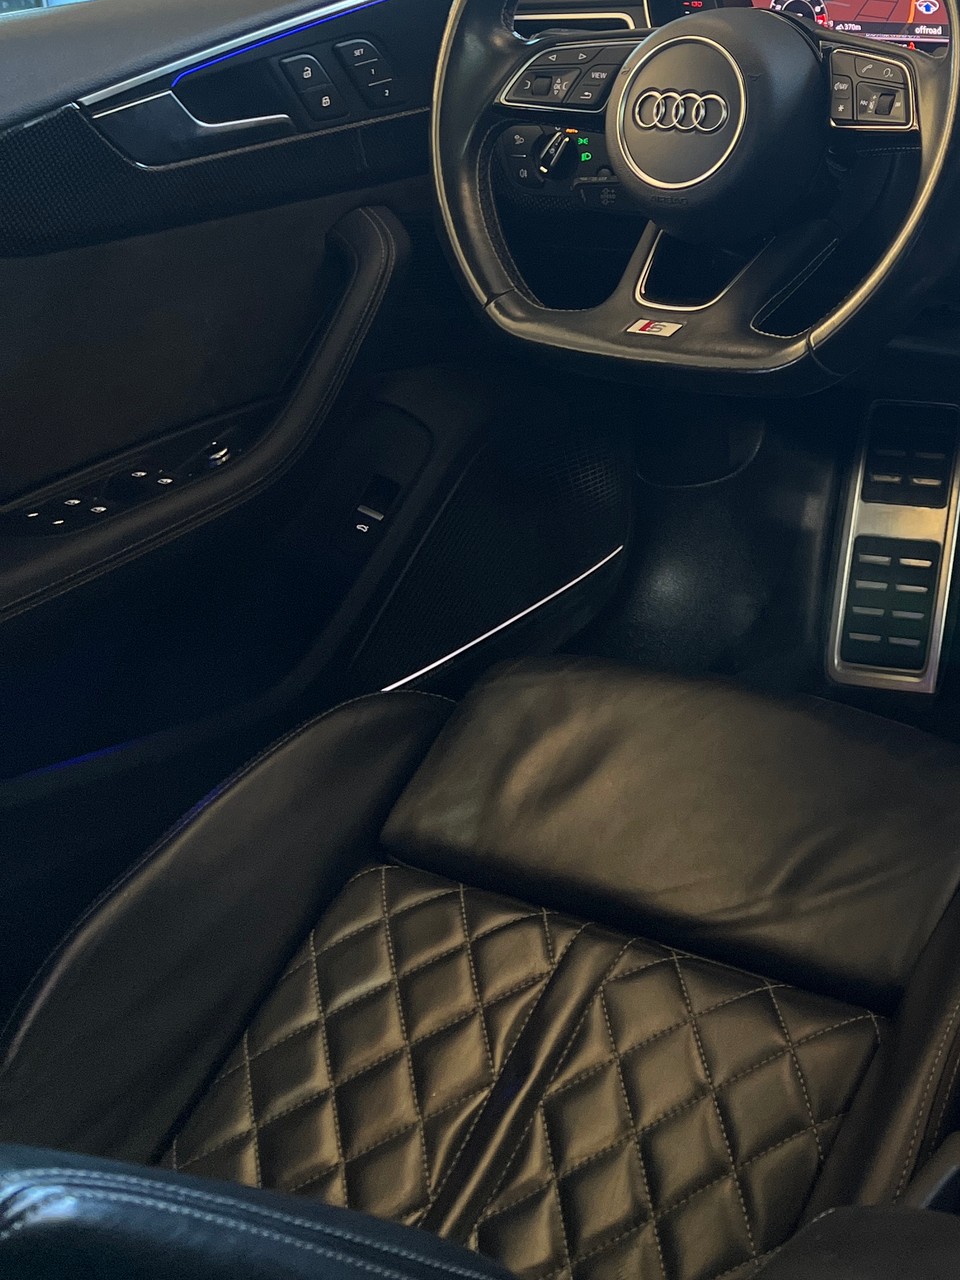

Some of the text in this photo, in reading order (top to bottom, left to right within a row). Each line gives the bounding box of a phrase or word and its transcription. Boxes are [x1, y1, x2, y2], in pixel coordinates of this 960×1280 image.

[914, 25, 943, 35] offroad
[353, 48, 364, 57] SET
[591, 71, 608, 79] VIEW
